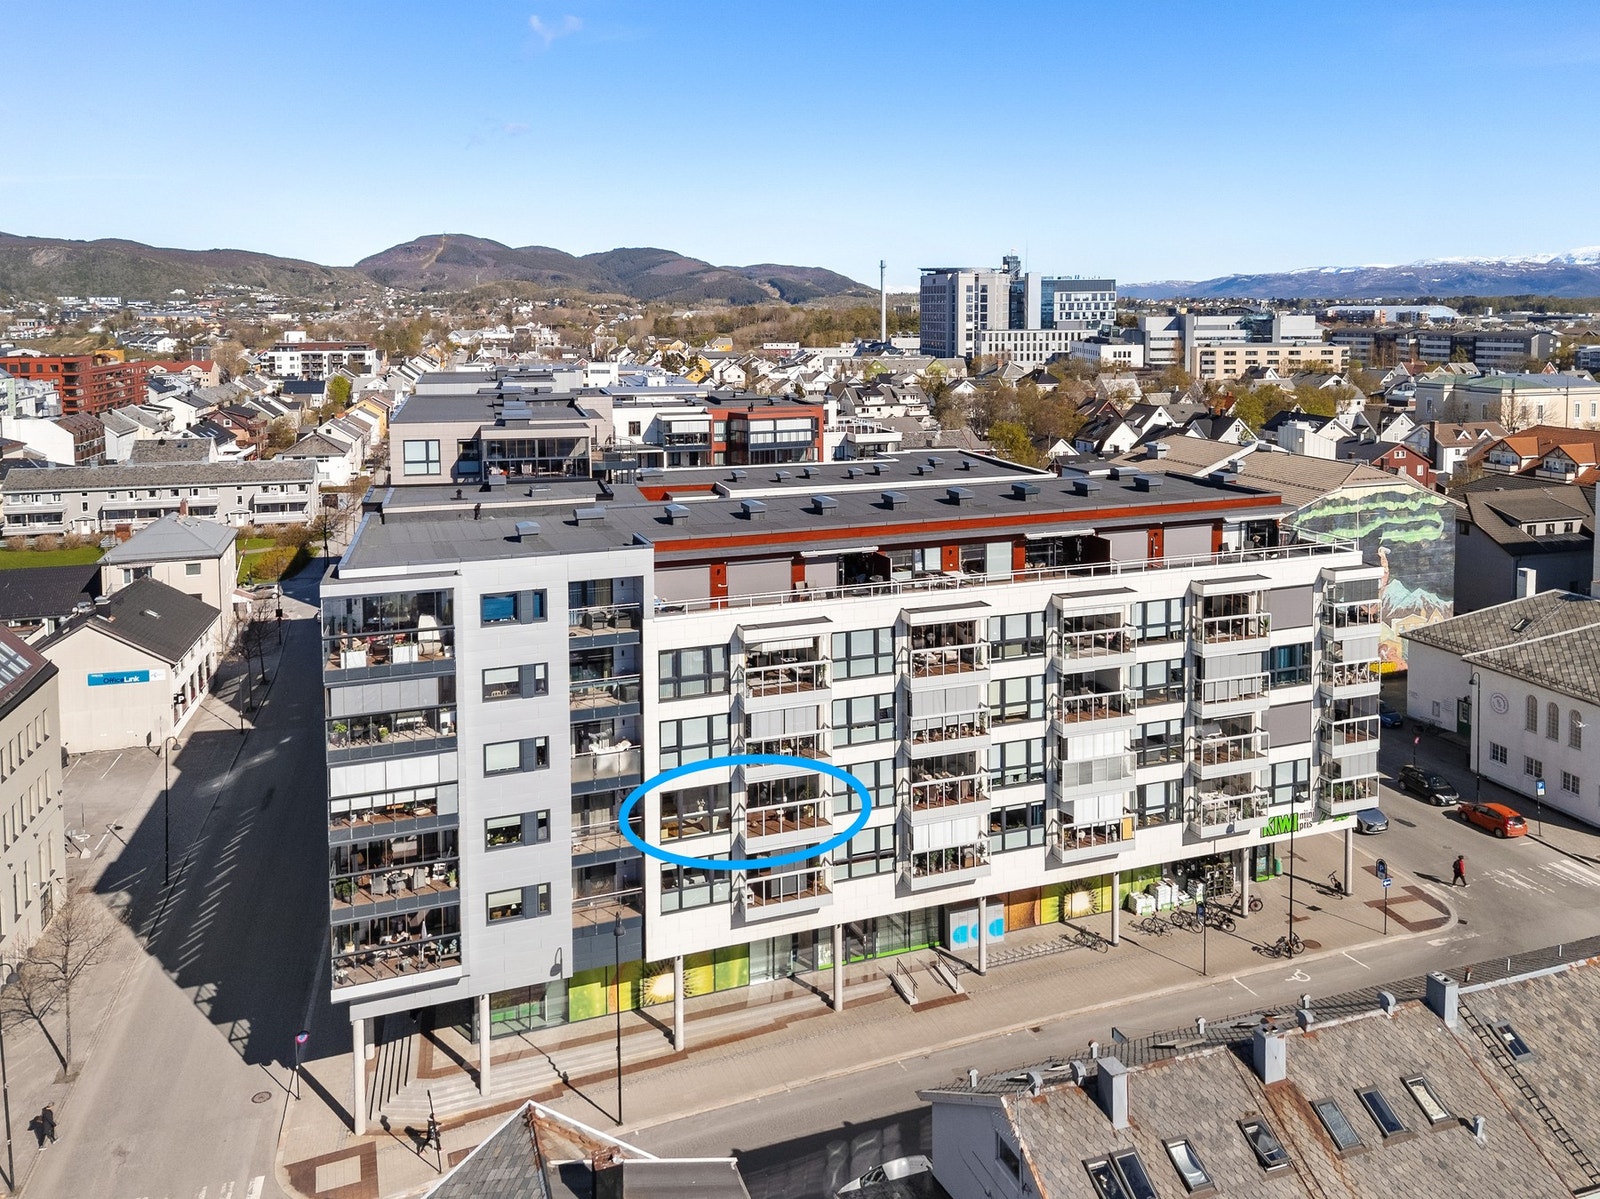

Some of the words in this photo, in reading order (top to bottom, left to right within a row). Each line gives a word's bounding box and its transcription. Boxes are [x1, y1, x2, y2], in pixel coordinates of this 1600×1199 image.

[178, 695, 184, 703] P
[1261, 812, 1299, 838] KIWI
[1299, 819, 1313, 832] pris
